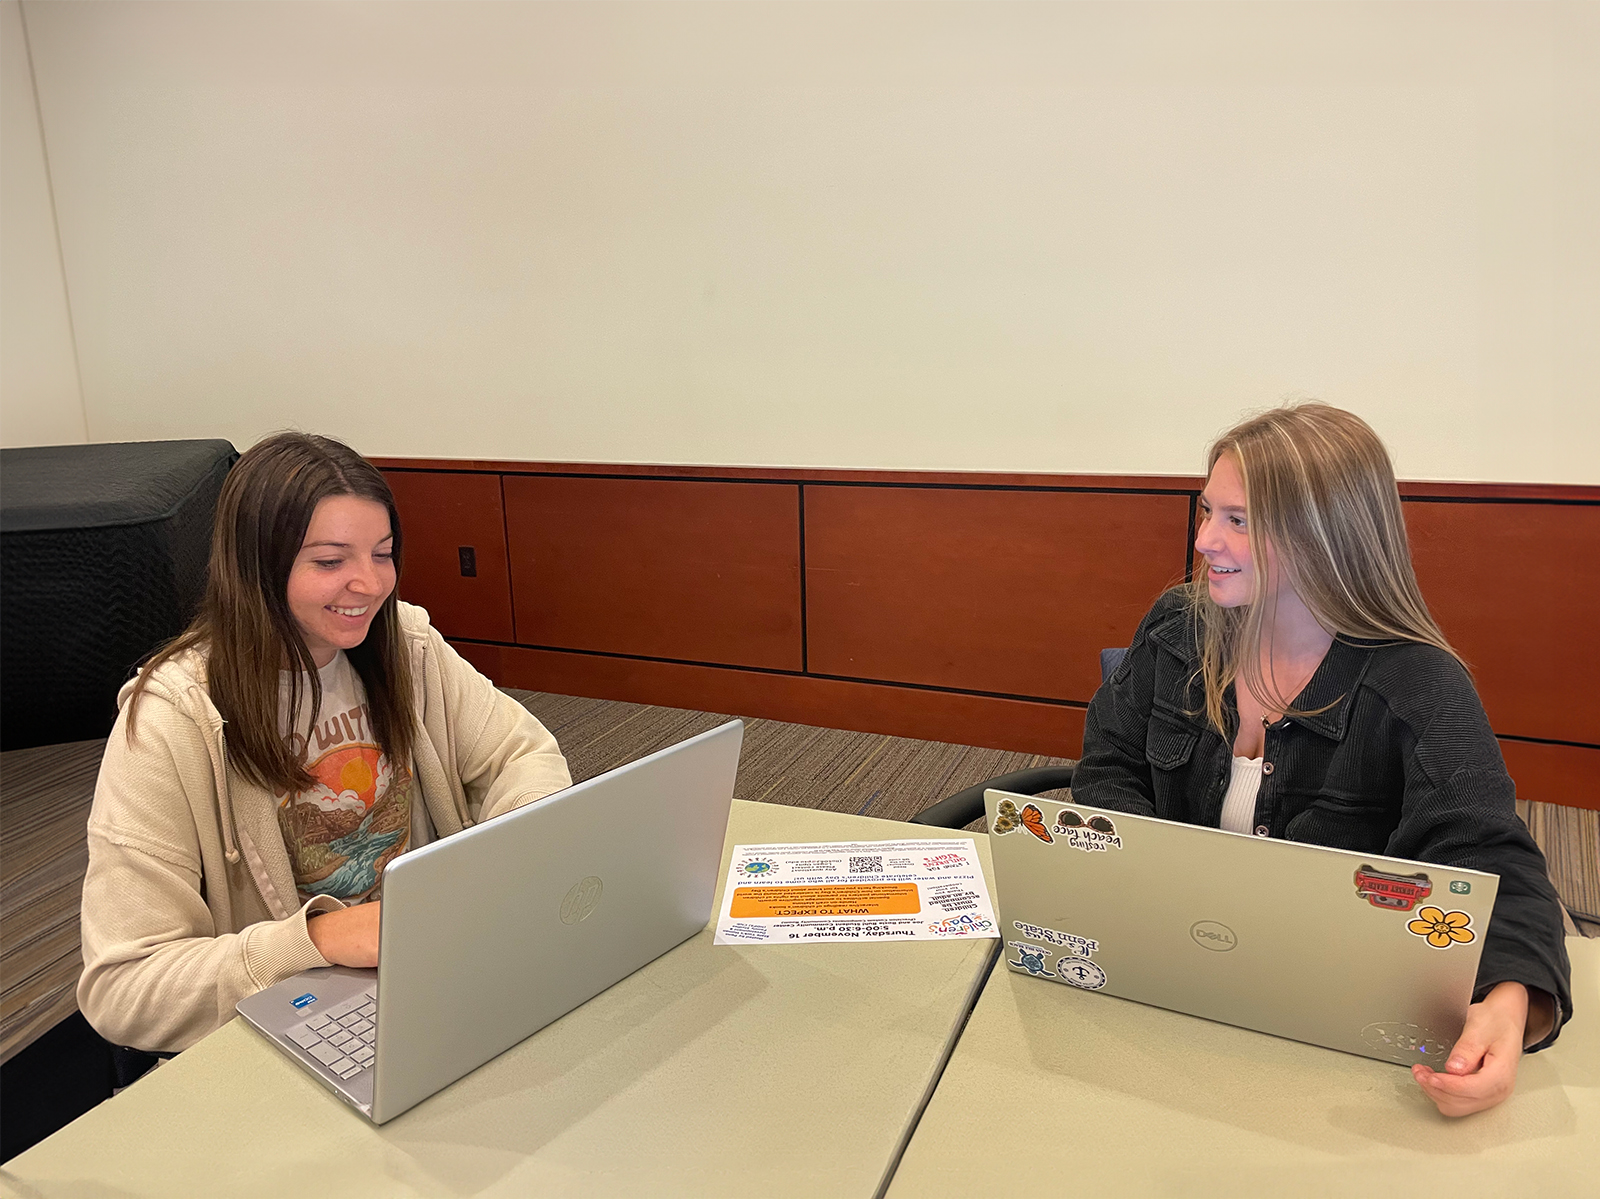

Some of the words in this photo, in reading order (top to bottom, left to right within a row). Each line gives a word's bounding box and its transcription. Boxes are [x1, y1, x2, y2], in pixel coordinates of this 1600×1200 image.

[314, 703, 368, 750] WIT
[1053, 826, 1080, 839] face
[1083, 831, 1121, 848] beach
[1070, 838, 1105, 851] resting
[928, 895, 980, 905] accompanied
[929, 920, 992, 934] Children's
[942, 915, 972, 926] Day
[1014, 922, 1053, 938] State
[1024, 931, 1040, 940] us
[1196, 929, 1233, 944] DELL
[1057, 932, 1096, 950] Penn
